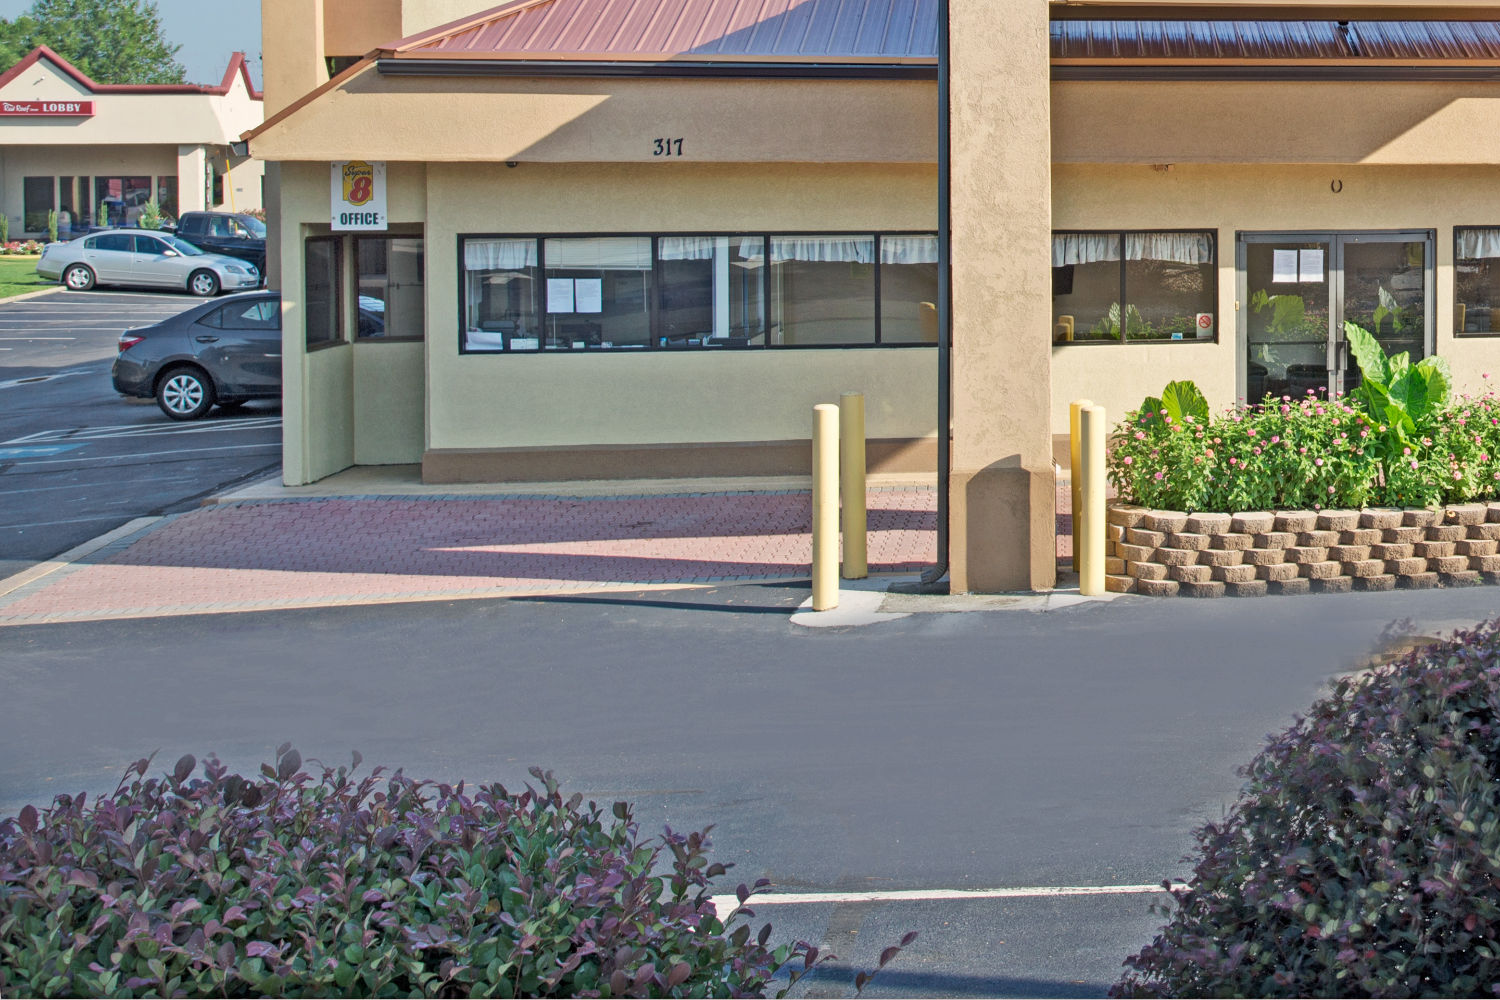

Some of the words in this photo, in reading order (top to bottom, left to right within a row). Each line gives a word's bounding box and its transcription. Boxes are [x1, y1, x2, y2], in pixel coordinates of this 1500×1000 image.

[43, 103, 81, 112] LOBBY
[653, 138, 684, 156] 317
[345, 165, 371, 181] Super
[348, 176, 372, 203] 8
[340, 212, 379, 225] OFFICE
